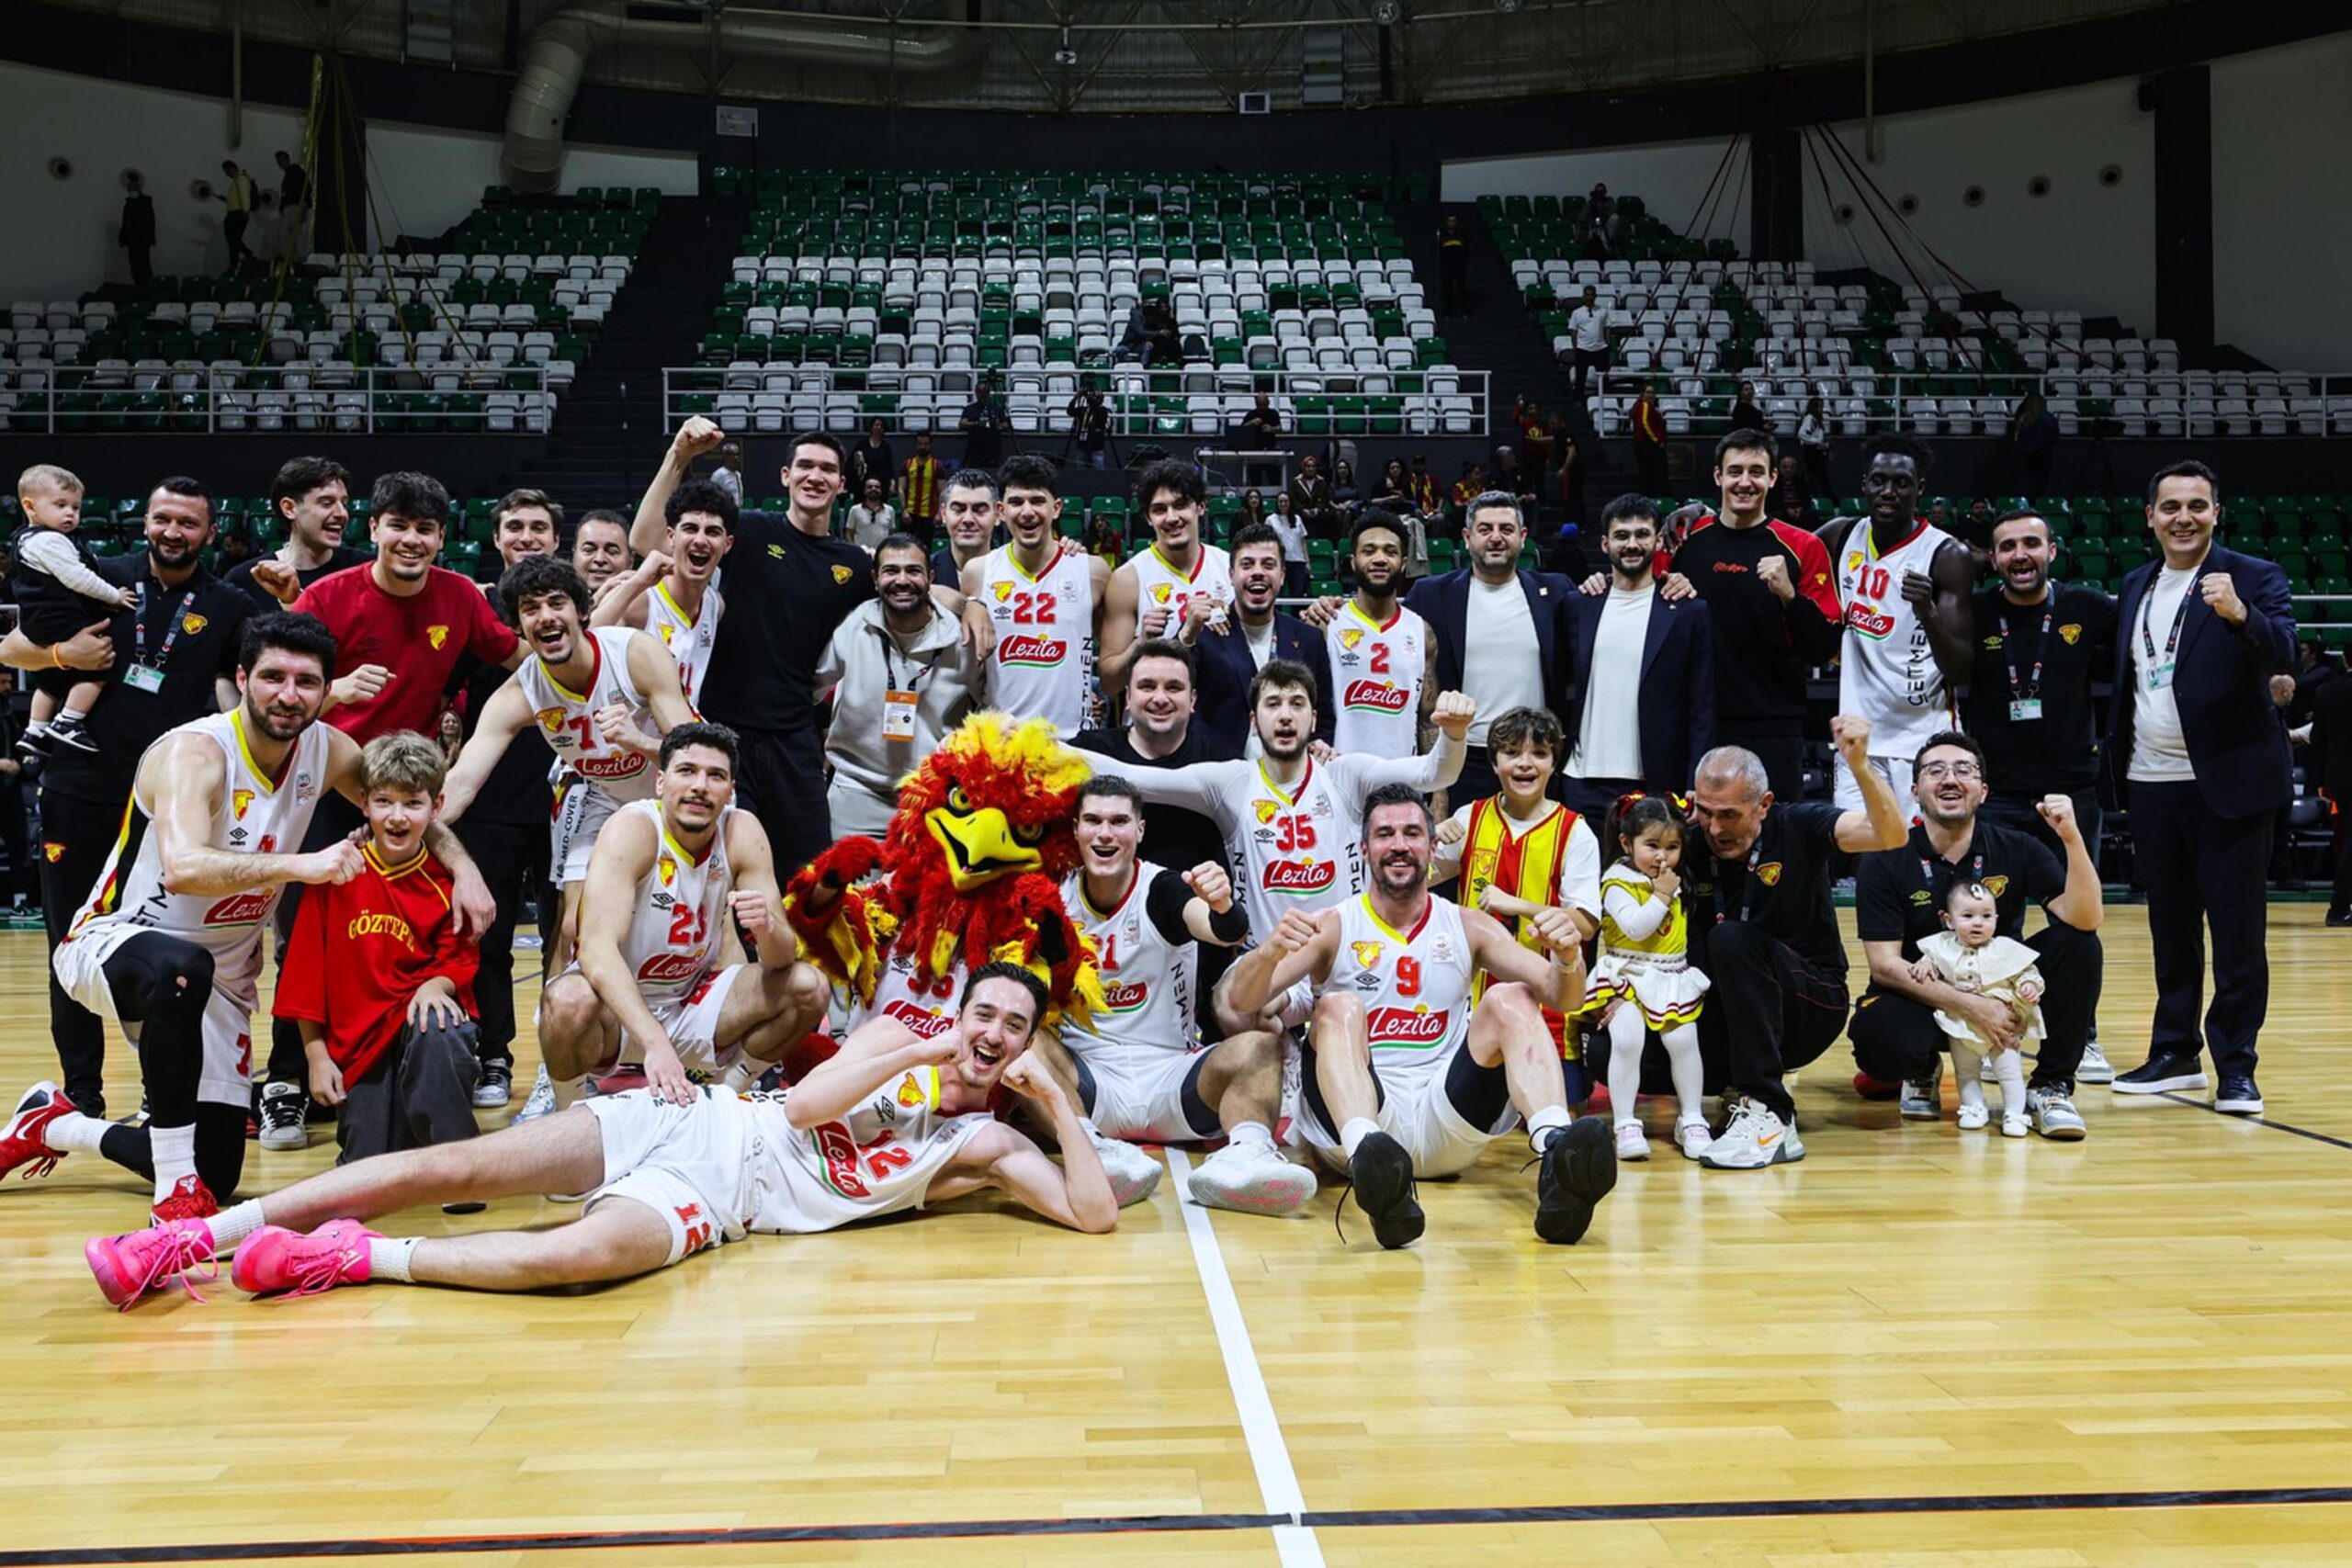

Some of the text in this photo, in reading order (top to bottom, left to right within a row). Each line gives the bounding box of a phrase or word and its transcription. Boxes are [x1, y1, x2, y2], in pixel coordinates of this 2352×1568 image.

[1857, 565, 1890, 600] 10
[1013, 592, 1056, 624] 22
[1005, 636, 1061, 659] Lezita
[1370, 643, 1390, 673] 2
[1350, 678, 1404, 705] Lezita
[581, 751, 640, 775] Lezita
[560, 795, 578, 861] MED-COVER
[1276, 814, 1317, 852] 35
[1270, 860, 1329, 885] Lezita
[349, 909, 414, 953] GÖZTEPE
[1396, 956, 1420, 998] 9
[1370, 1007, 1442, 1036] Lezita
[857, 1129, 912, 1180] 12
[673, 1201, 710, 1257] 12
